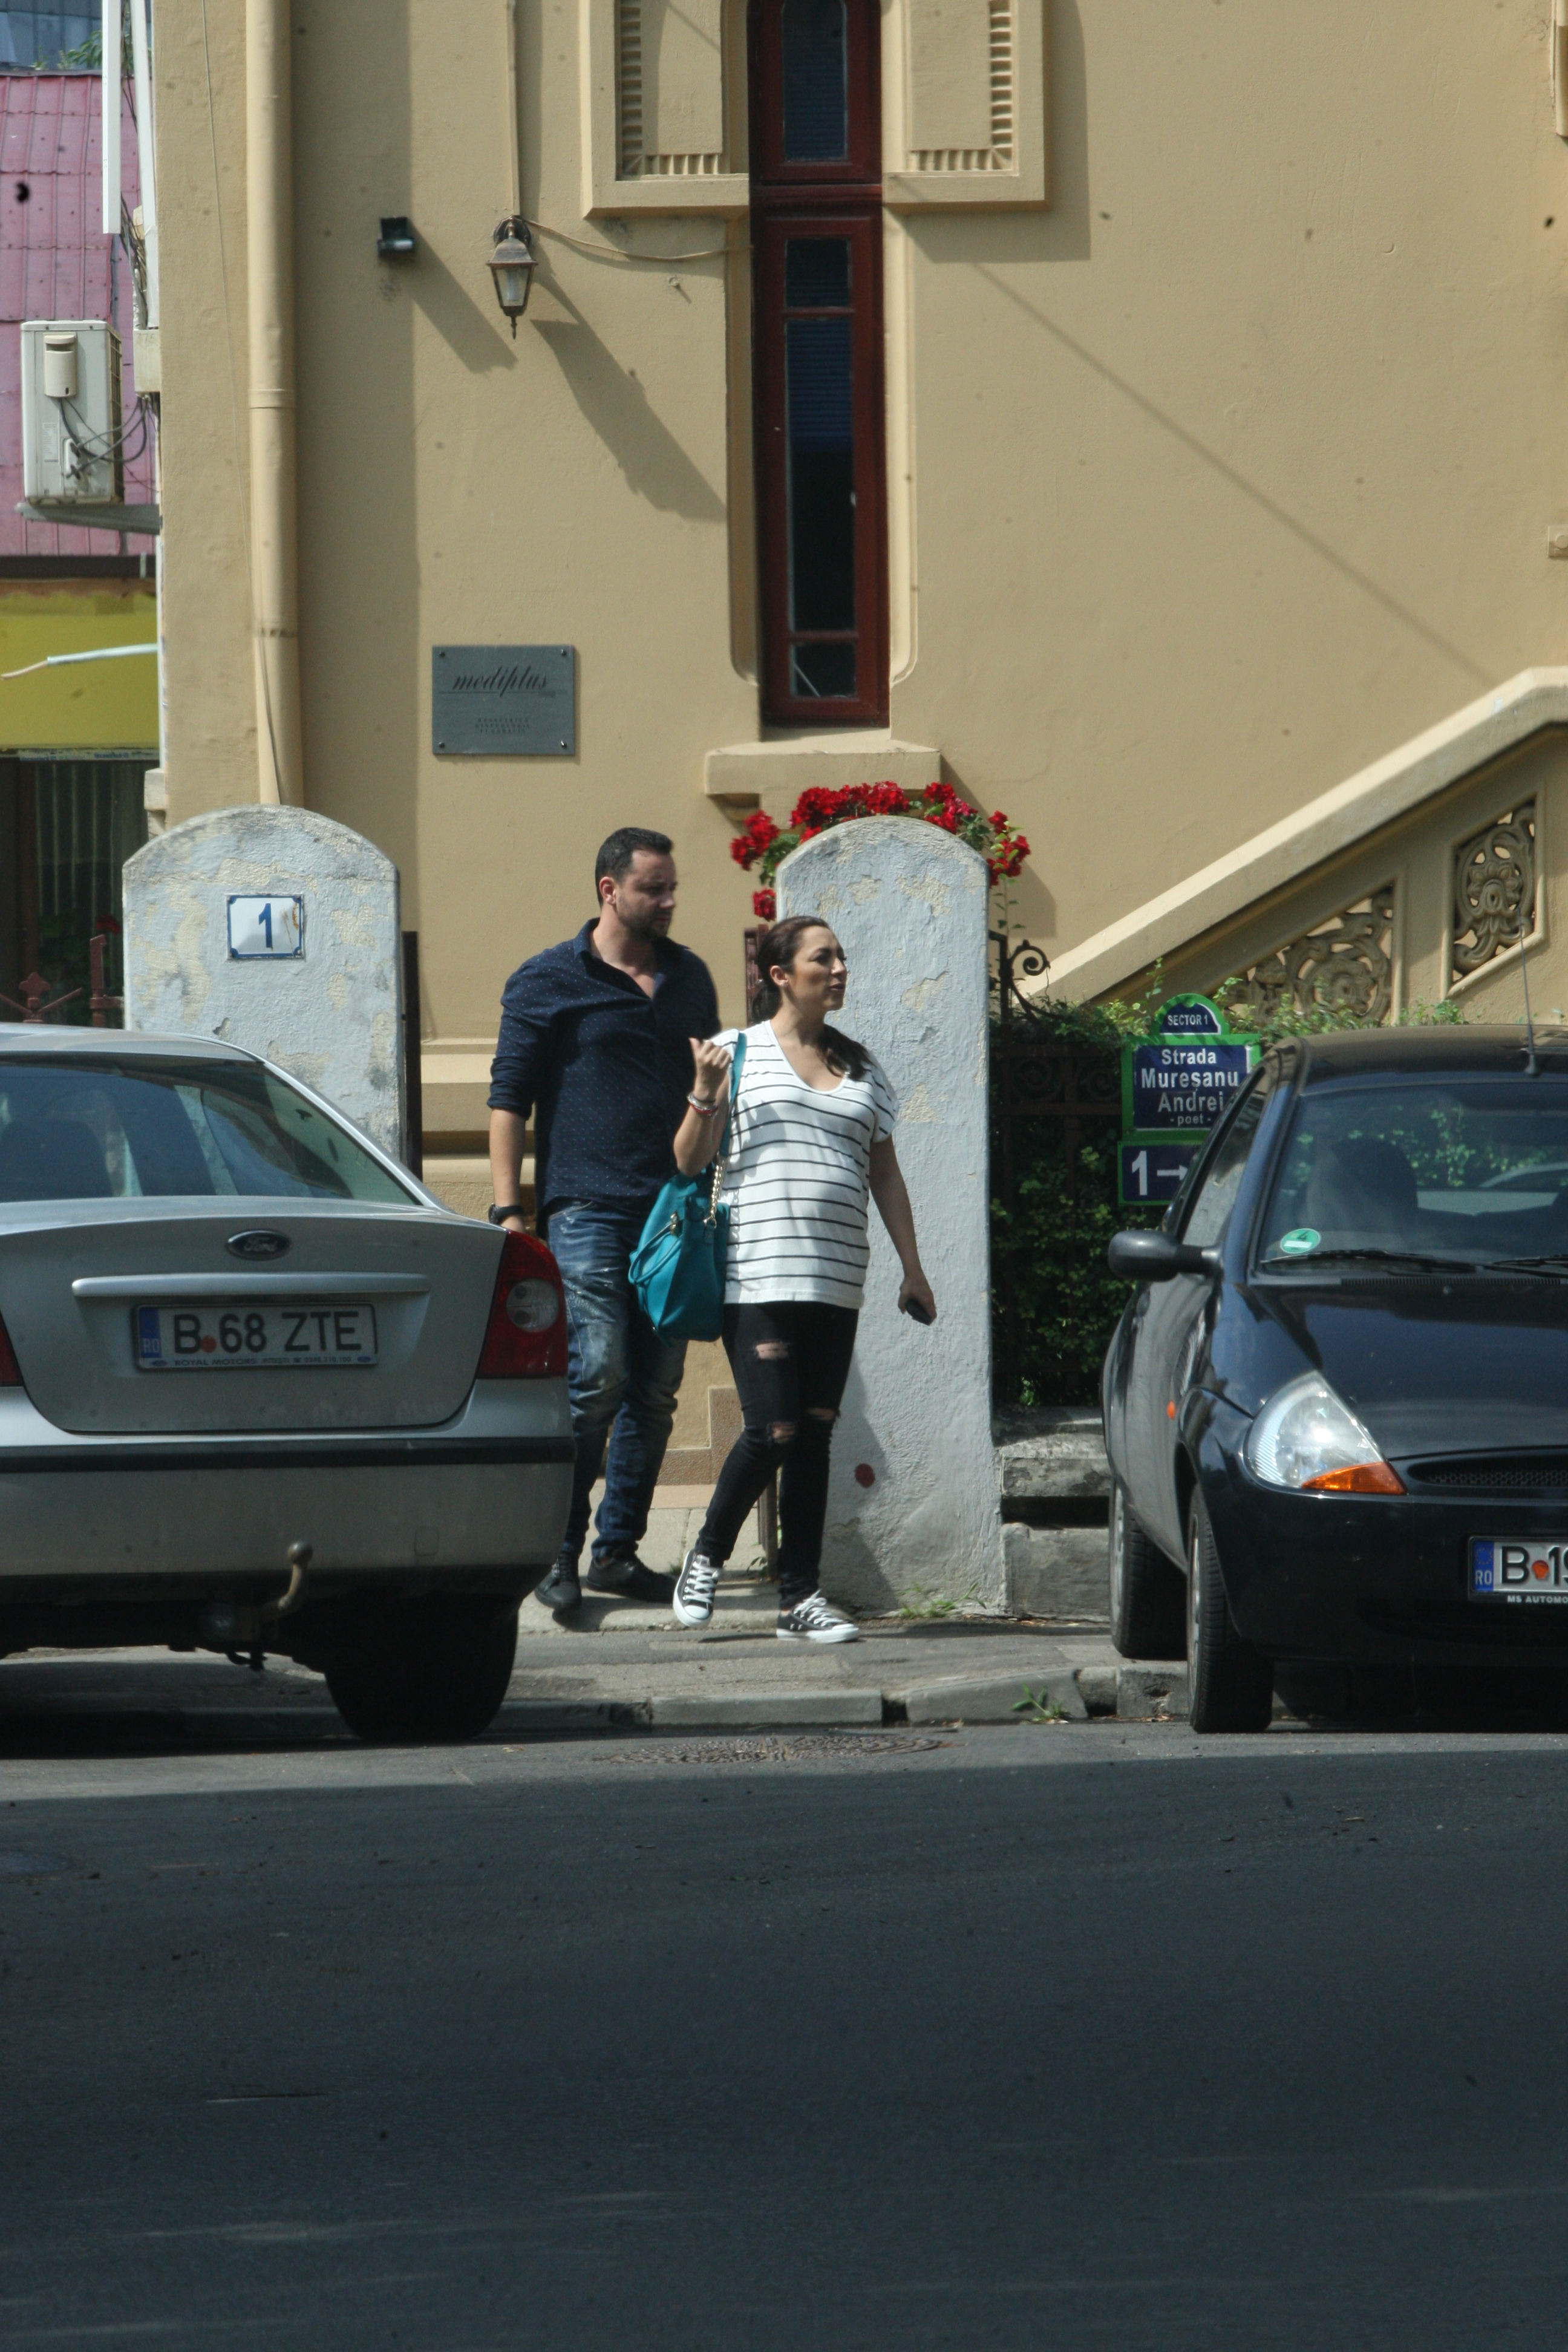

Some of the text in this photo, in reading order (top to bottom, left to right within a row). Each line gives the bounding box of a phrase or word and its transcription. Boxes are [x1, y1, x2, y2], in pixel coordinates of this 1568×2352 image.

[258, 903, 273, 949] 1
[1167, 1014, 1208, 1026] SECTOR 1
[1161, 1048, 1217, 1065] Strada
[1158, 1091, 1224, 1113] Andrei
[1177, 1114, 1204, 1126] poet
[1131, 1150, 1148, 1196] 1
[243, 1236, 279, 1252] Ford
[281, 1311, 362, 1353] ZTE
[143, 1338, 160, 1354] RO
[1501, 1546, 1568, 1586] B 1
[1475, 1570, 1492, 1585] RO
[1525, 1595, 1568, 1604] AUTOMO
